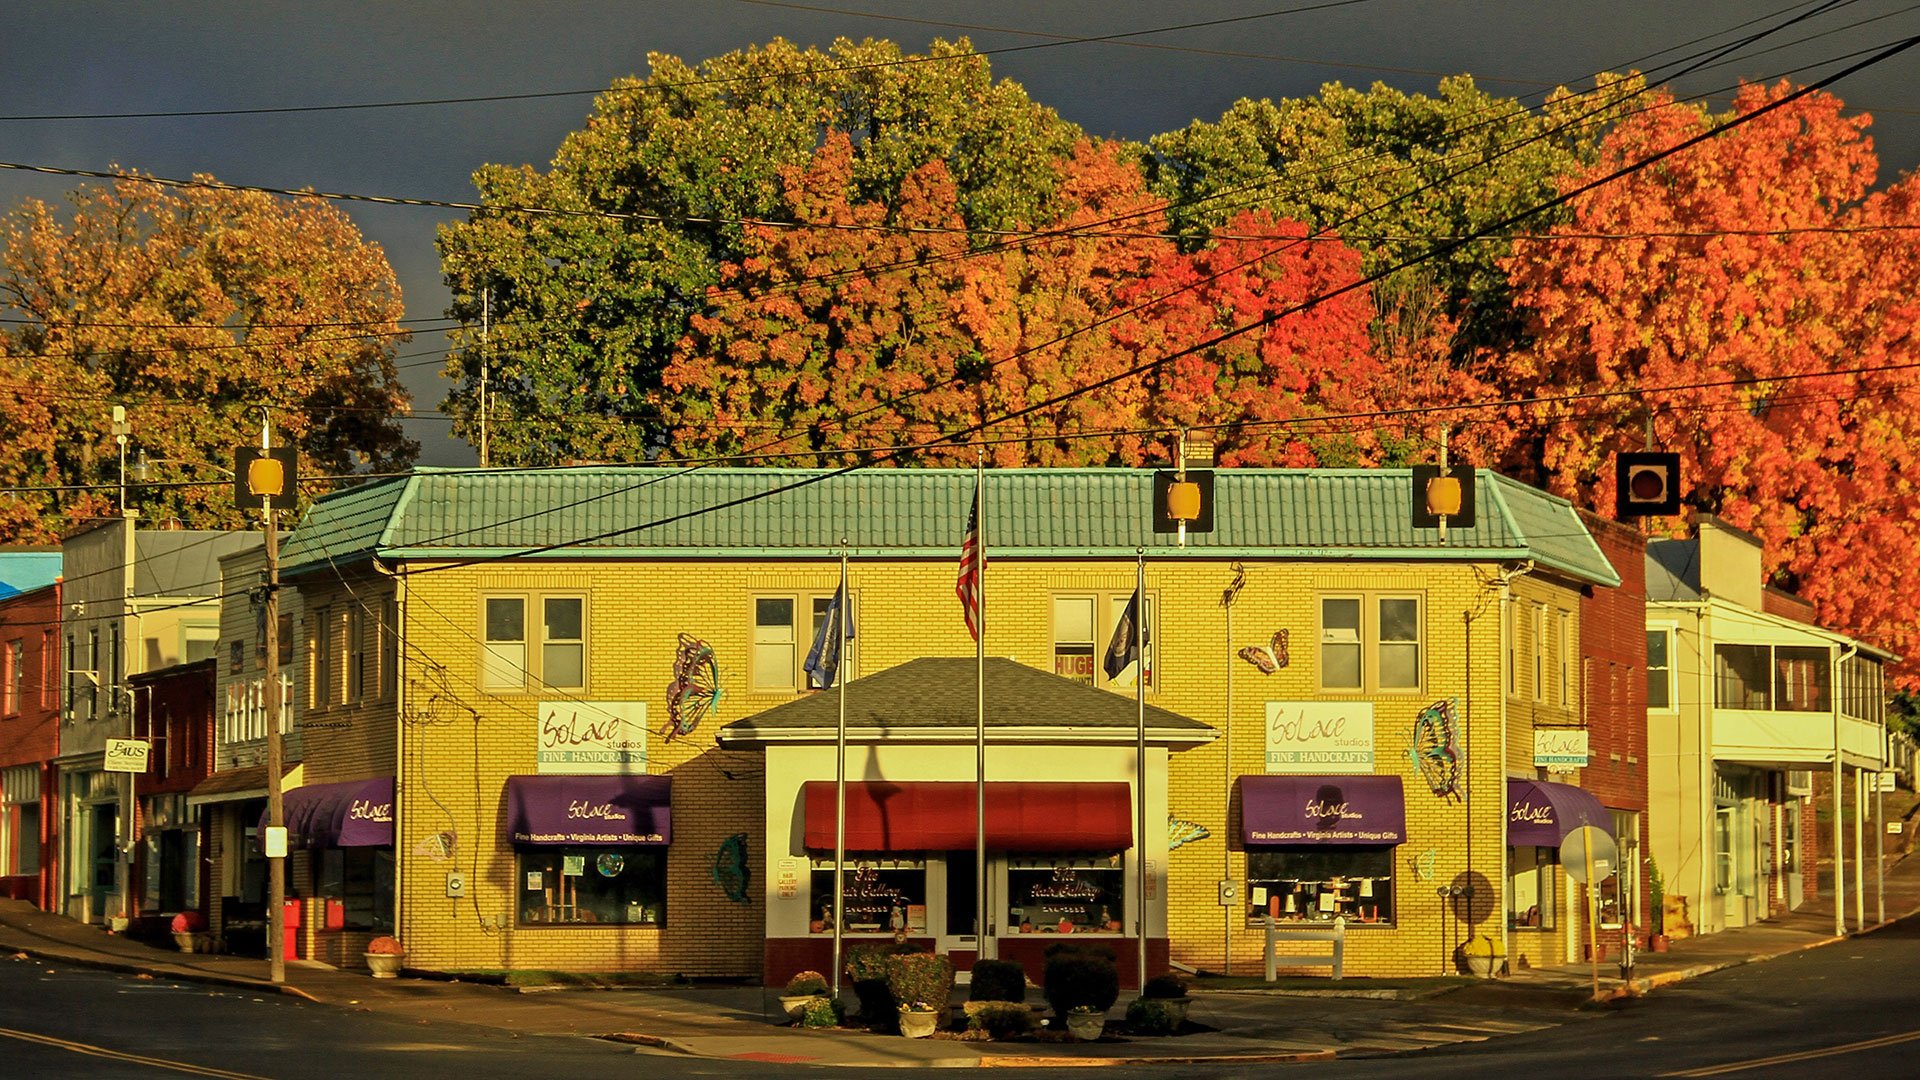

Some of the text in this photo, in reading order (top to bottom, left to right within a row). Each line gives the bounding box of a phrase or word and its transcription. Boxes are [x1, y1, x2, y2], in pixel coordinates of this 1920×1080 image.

[1055, 656, 1094, 676] HUGE
[607, 740, 642, 749] studios
[1334, 737, 1371, 748] studios
[543, 752, 642, 763] FINE HANDCRAFTS
[1271, 752, 1369, 763] FINE HANDCRAFTS
[515, 833, 663, 843] Fine Handcrafts Virginia Artists Unique Gifts
[1252, 831, 1398, 841] Fine Handcrafts Virginia Artists Unique Gifts
